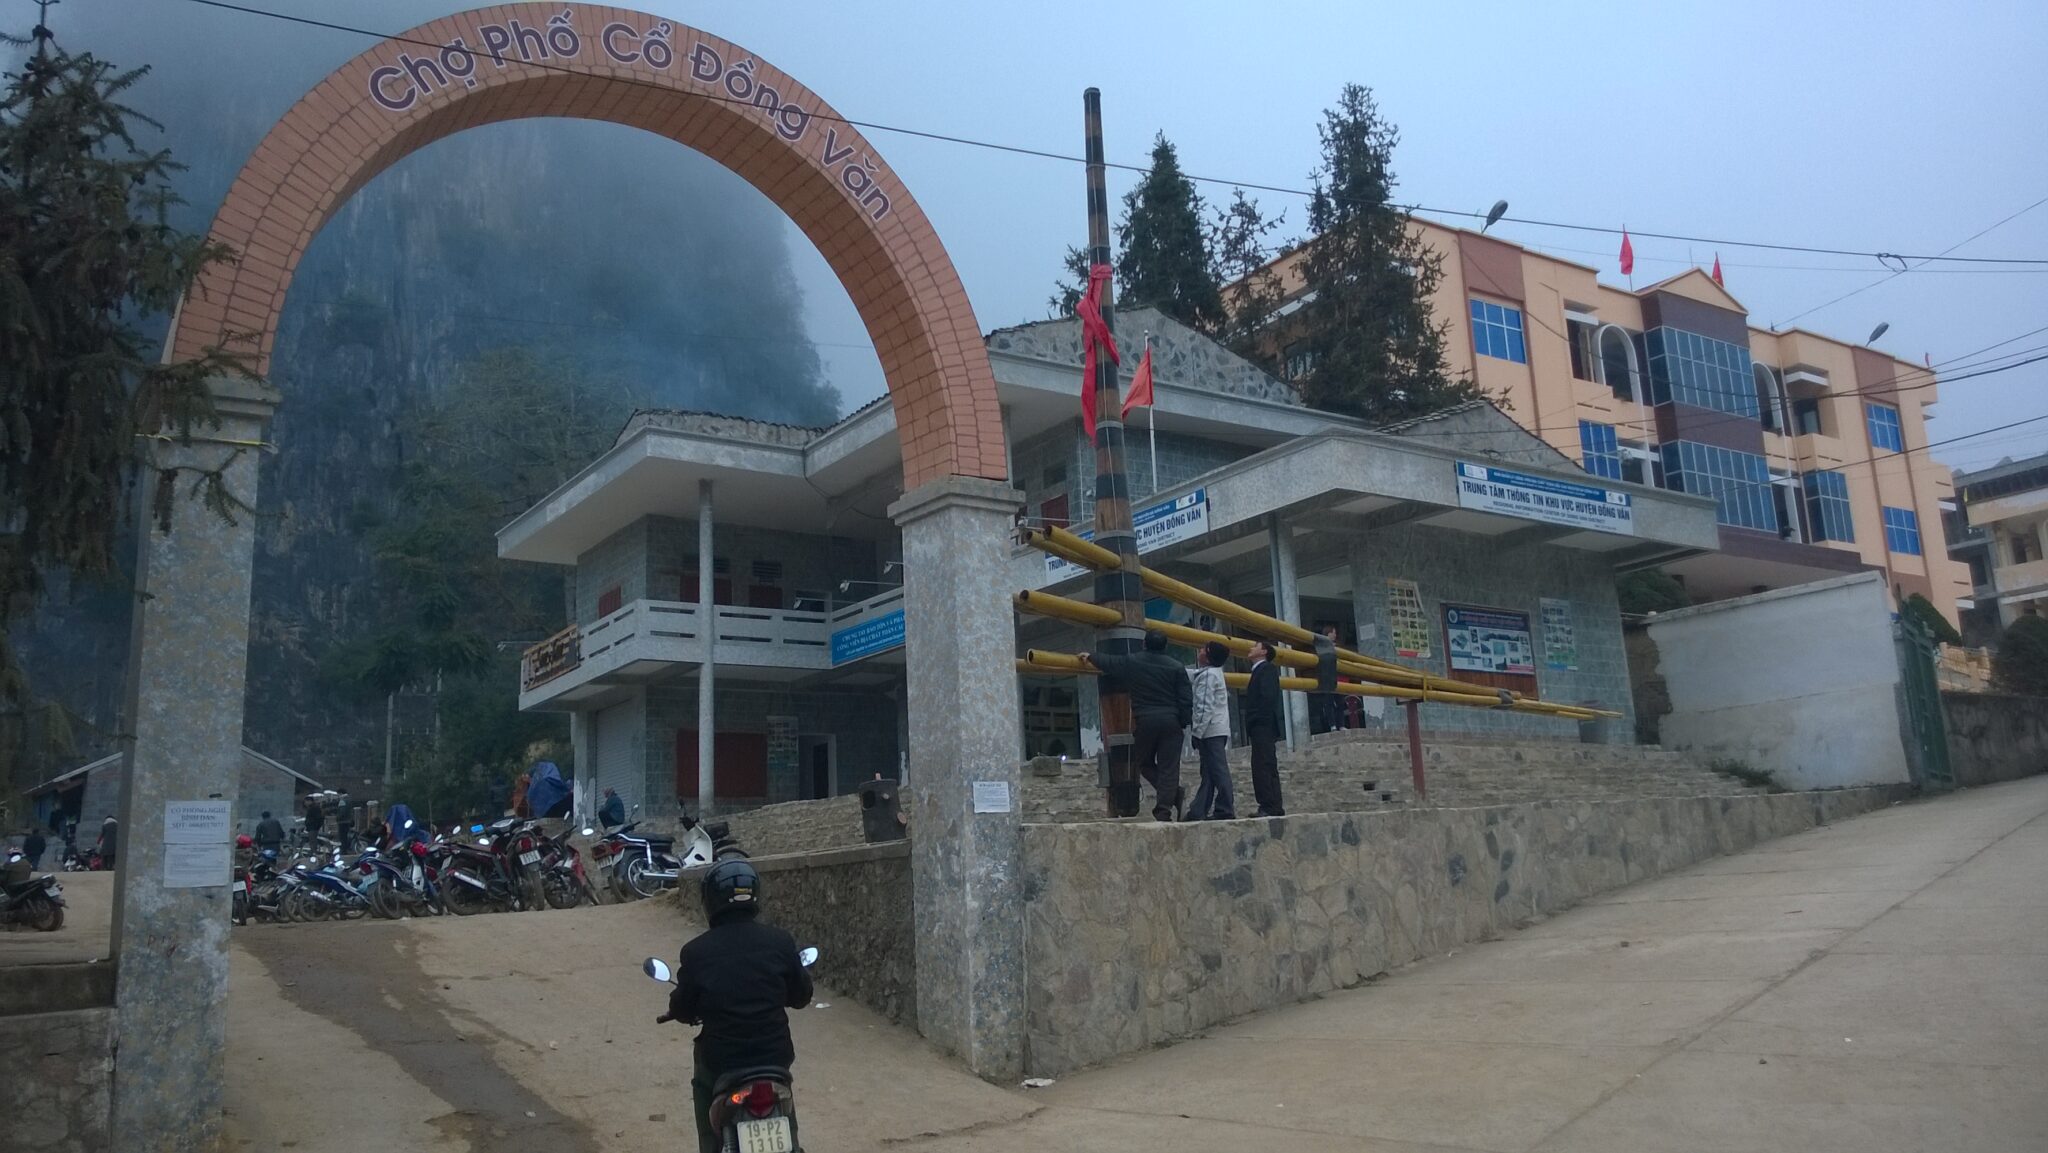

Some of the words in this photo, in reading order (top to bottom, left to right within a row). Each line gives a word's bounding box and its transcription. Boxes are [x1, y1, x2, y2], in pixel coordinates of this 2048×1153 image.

[368, 38, 477, 111] Chợ
[479, 8, 580, 67] Phố
[601, 20, 674, 70] Cổ
[688, 42, 811, 142] Đồng
[819, 127, 893, 222] Văn
[1463, 481, 1487, 496] TRUNG
[1489, 485, 1504, 499] TÂM
[1507, 488, 1530, 503] THÔNG
[1532, 493, 1544, 505] TIN
[1545, 496, 1559, 508] KHU
[1575, 500, 1597, 515] HUYỆN
[1143, 522, 1165, 539] HUYỆN
[1166, 514, 1185, 530] ĐỒNG
[1187, 509, 1202, 522] VĂN
[749, 1137, 784, 1153] 1316
